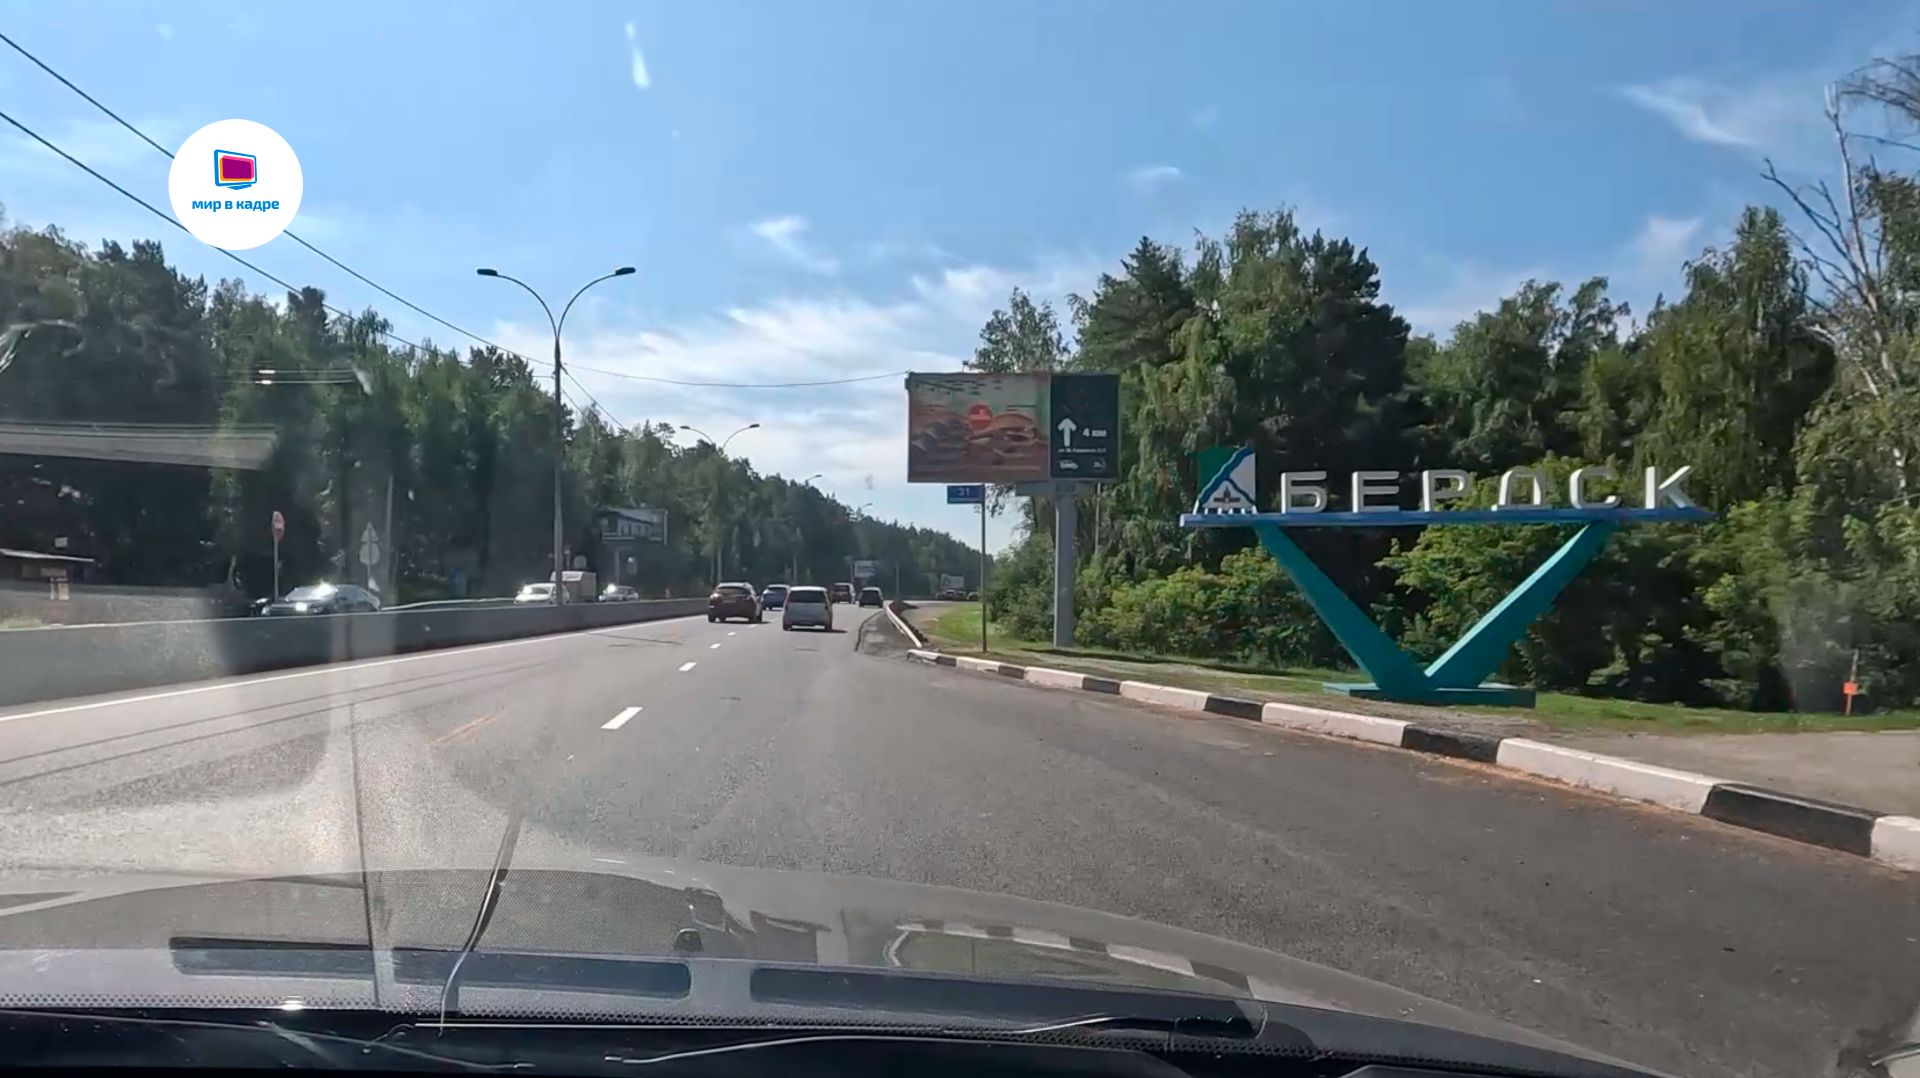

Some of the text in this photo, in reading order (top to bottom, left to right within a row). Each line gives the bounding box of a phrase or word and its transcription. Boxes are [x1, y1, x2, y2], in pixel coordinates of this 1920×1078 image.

[1082, 428, 1090, 437] 4
[957, 487, 970, 496] 31
[1280, 465, 1699, 514] БЕРДСК
